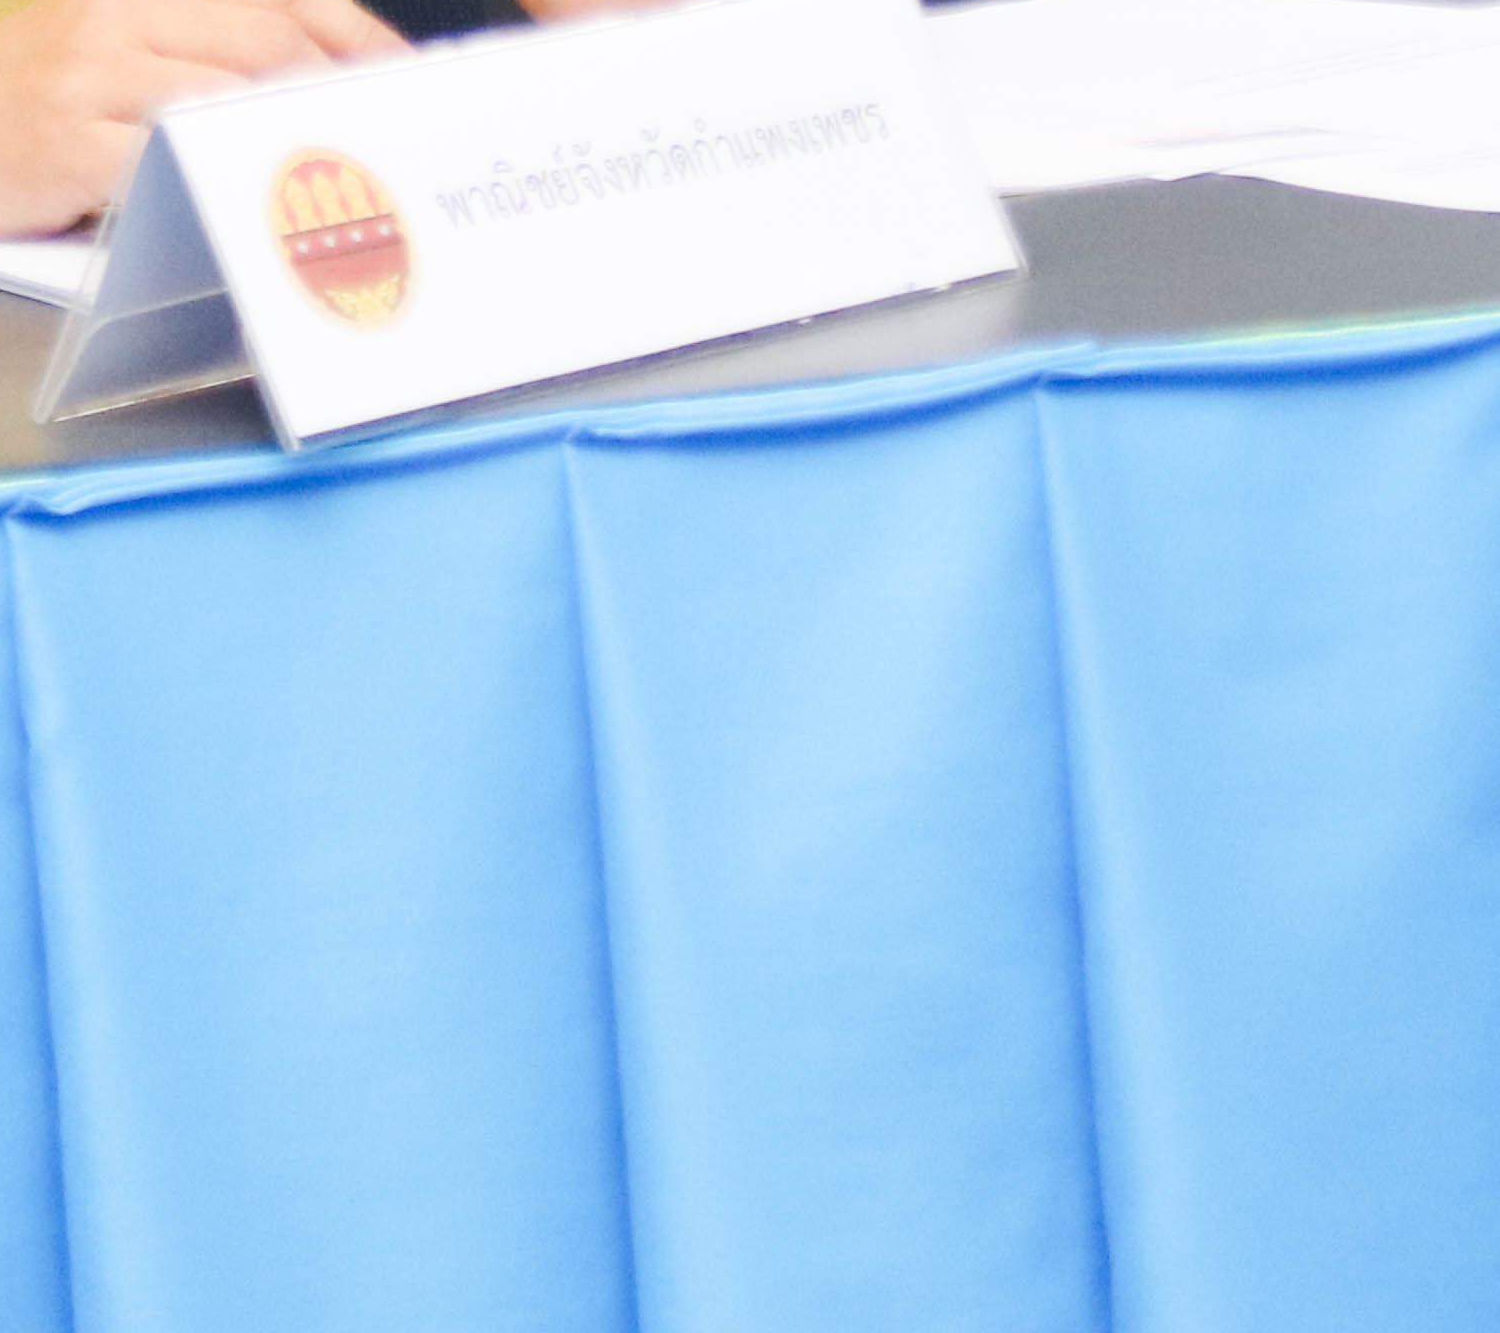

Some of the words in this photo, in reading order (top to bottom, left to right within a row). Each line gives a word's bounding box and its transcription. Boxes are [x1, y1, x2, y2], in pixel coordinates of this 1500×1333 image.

[433, 100, 891, 230] พาณิชย์จังหวัดกำแพงเพชร
